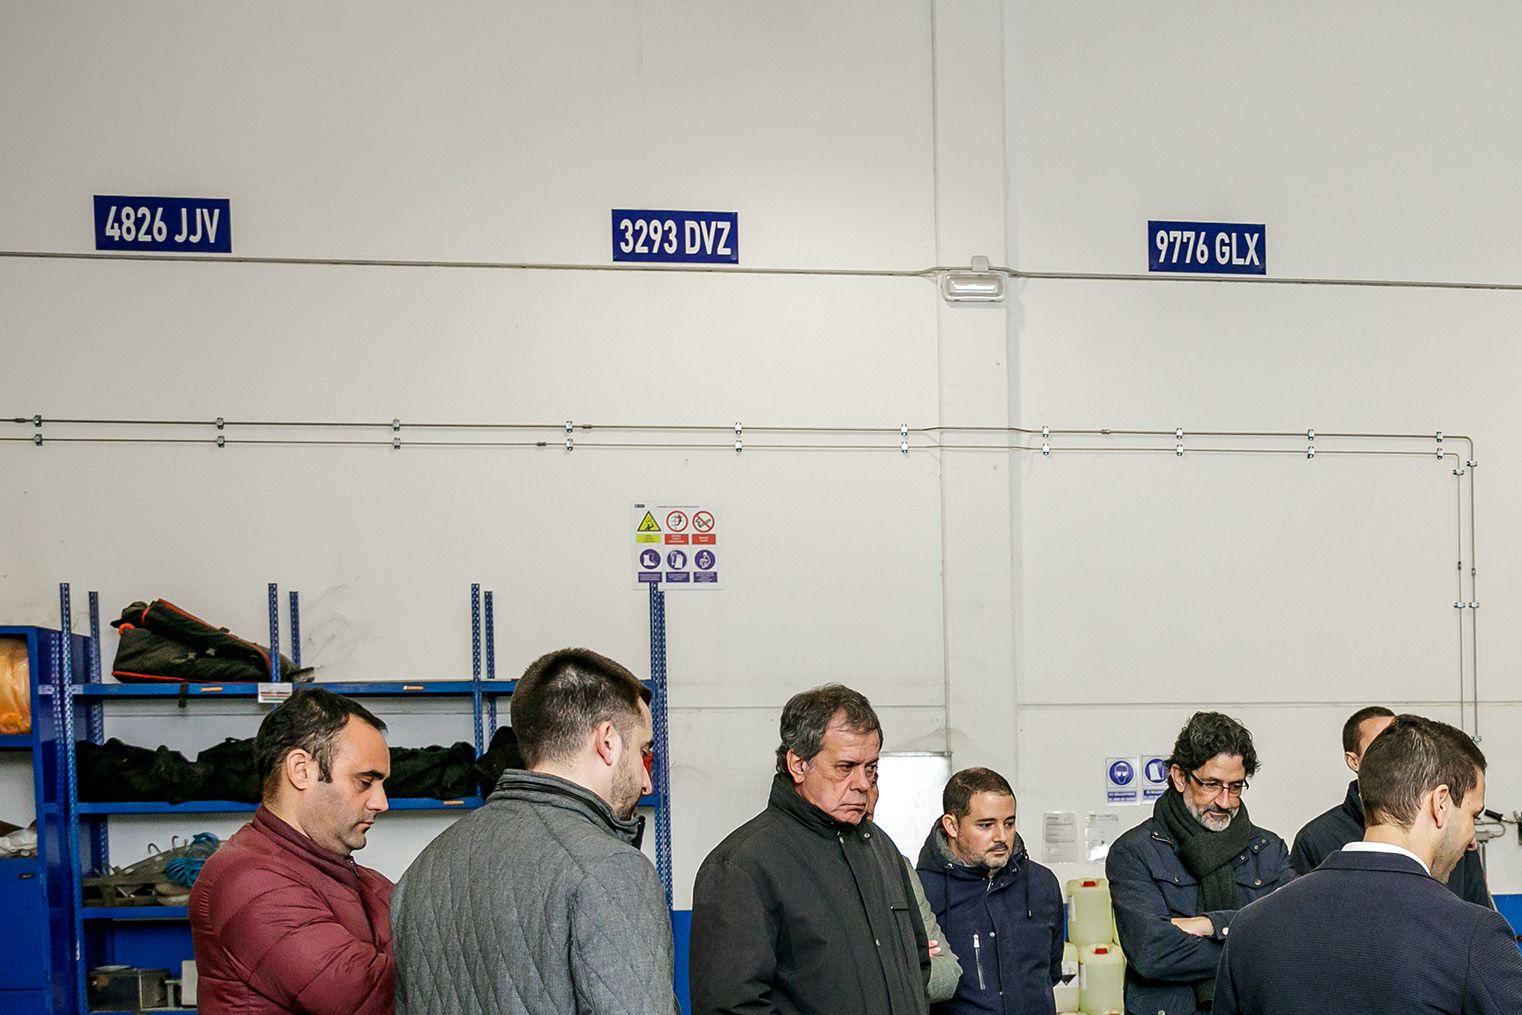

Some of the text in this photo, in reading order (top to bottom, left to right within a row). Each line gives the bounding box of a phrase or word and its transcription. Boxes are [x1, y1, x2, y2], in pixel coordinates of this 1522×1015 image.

[105, 205, 221, 245] 4826 JJV
[619, 218, 732, 257] 3293 DVZ
[1156, 230, 1261, 268] 9776 GLX
